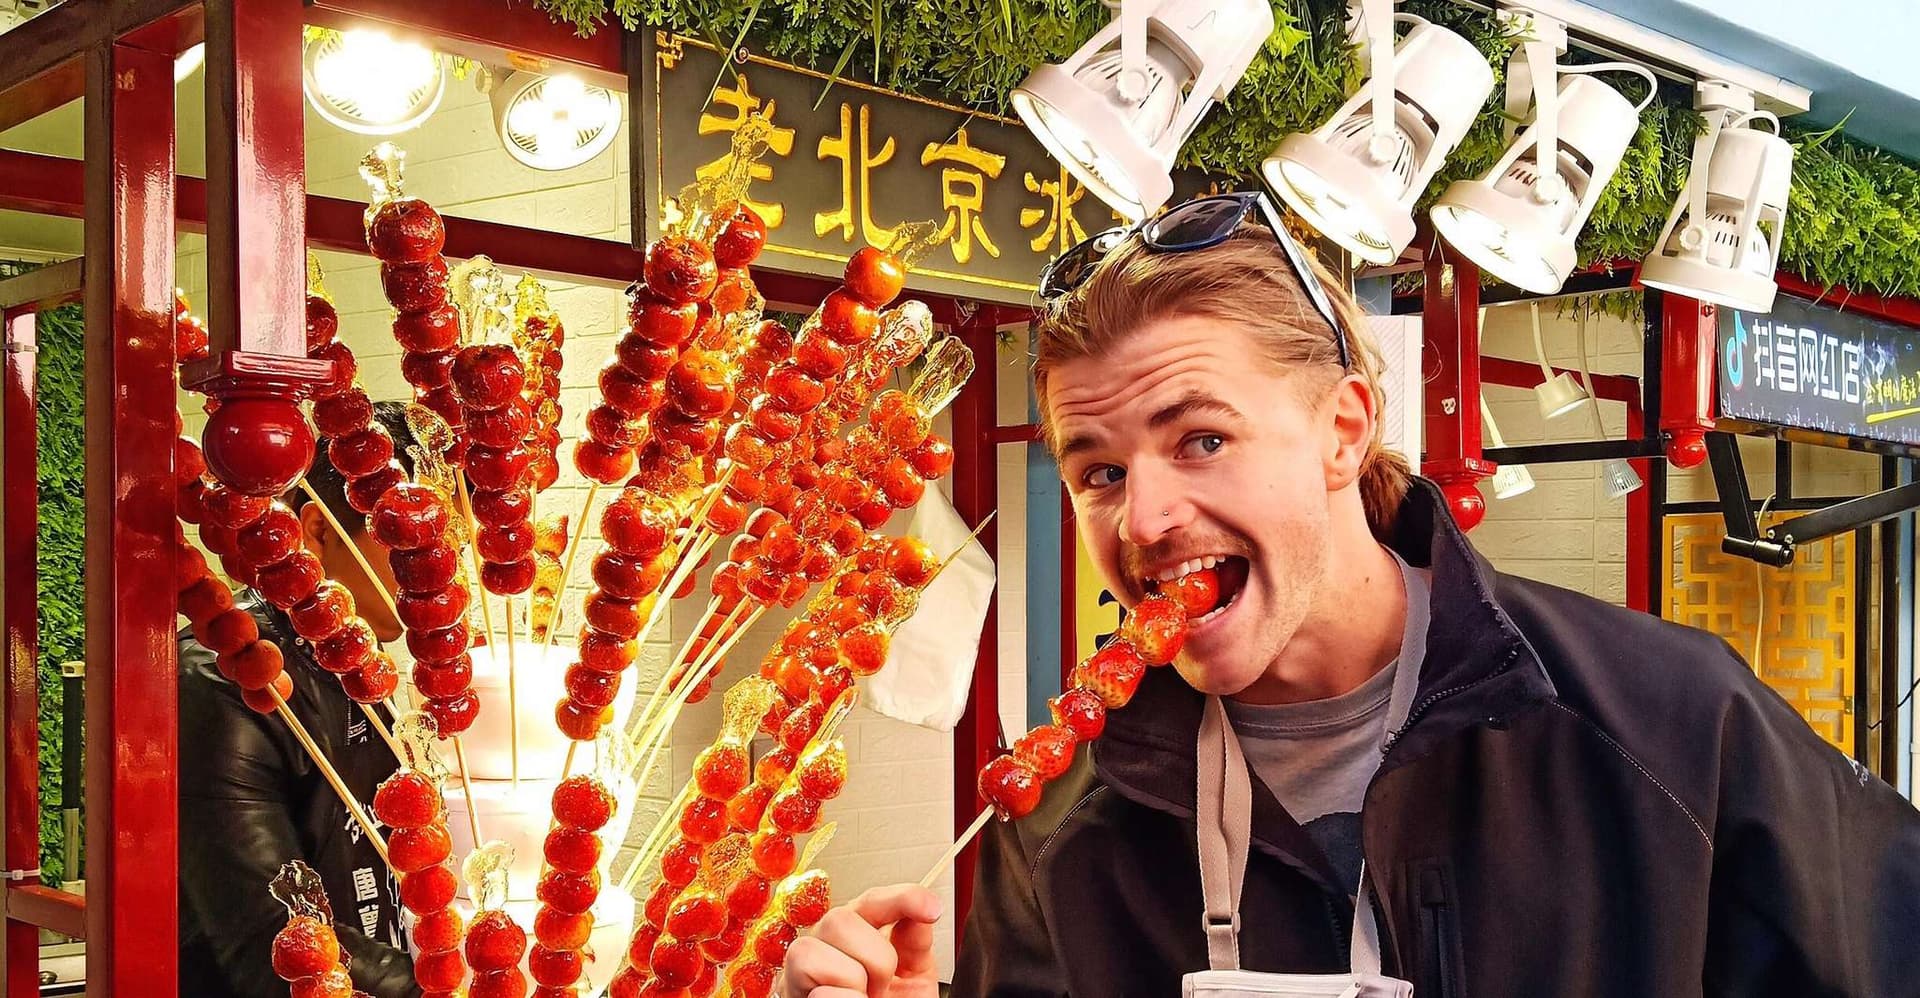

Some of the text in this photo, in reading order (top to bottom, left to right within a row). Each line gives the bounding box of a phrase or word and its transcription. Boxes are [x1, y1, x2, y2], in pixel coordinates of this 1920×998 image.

[695, 74, 1140, 264] 老北京冰
[1752, 318, 1860, 404] 抖音网红店
